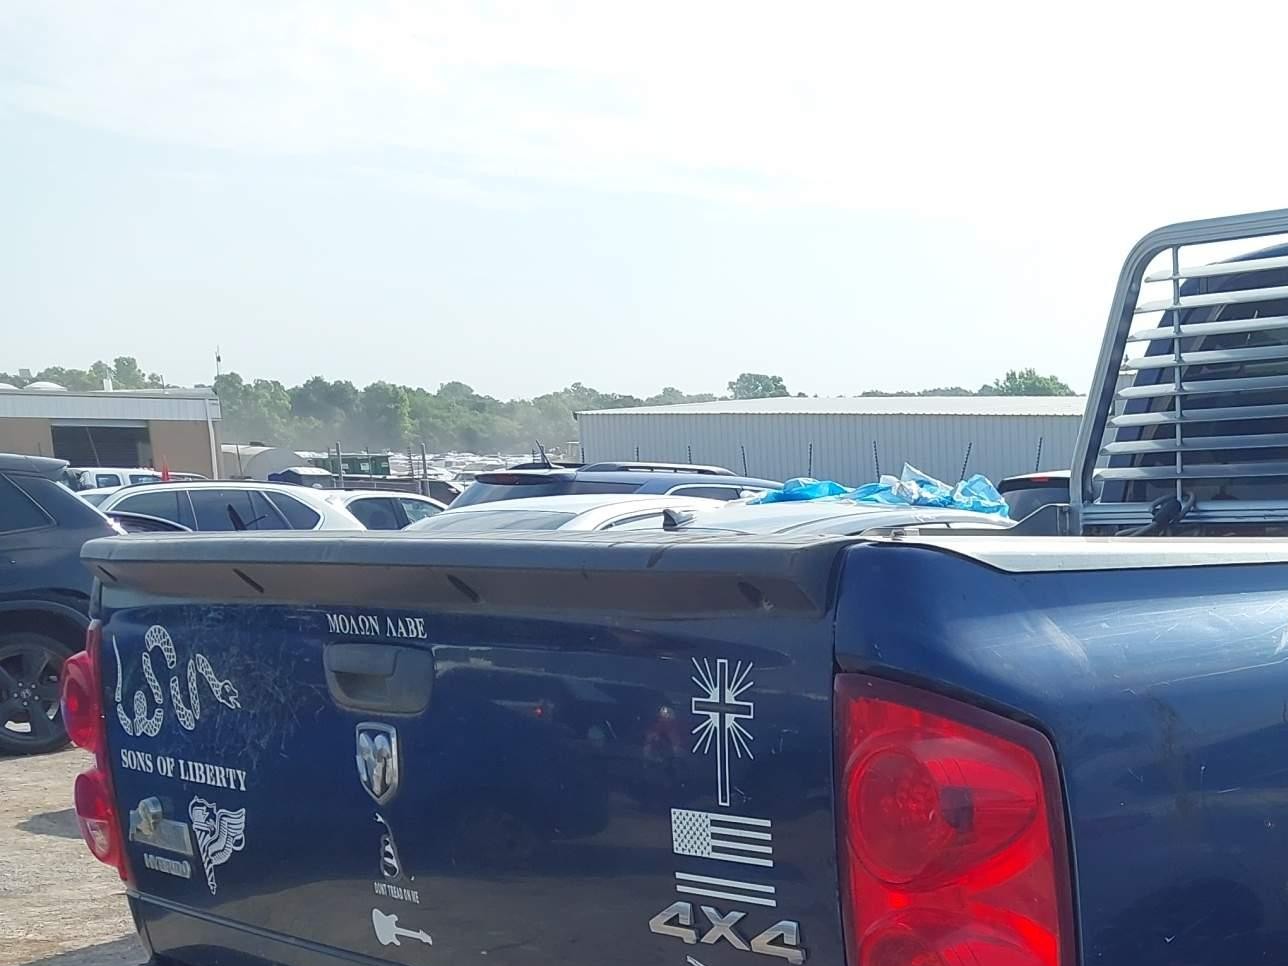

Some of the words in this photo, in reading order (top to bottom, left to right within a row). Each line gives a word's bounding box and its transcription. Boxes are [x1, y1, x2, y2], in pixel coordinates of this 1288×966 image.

[121, 748, 153, 773] SONS
[156, 756, 175, 777] OF
[178, 759, 246, 791] LIBERTY
[649, 901, 806, 965] 4X4
